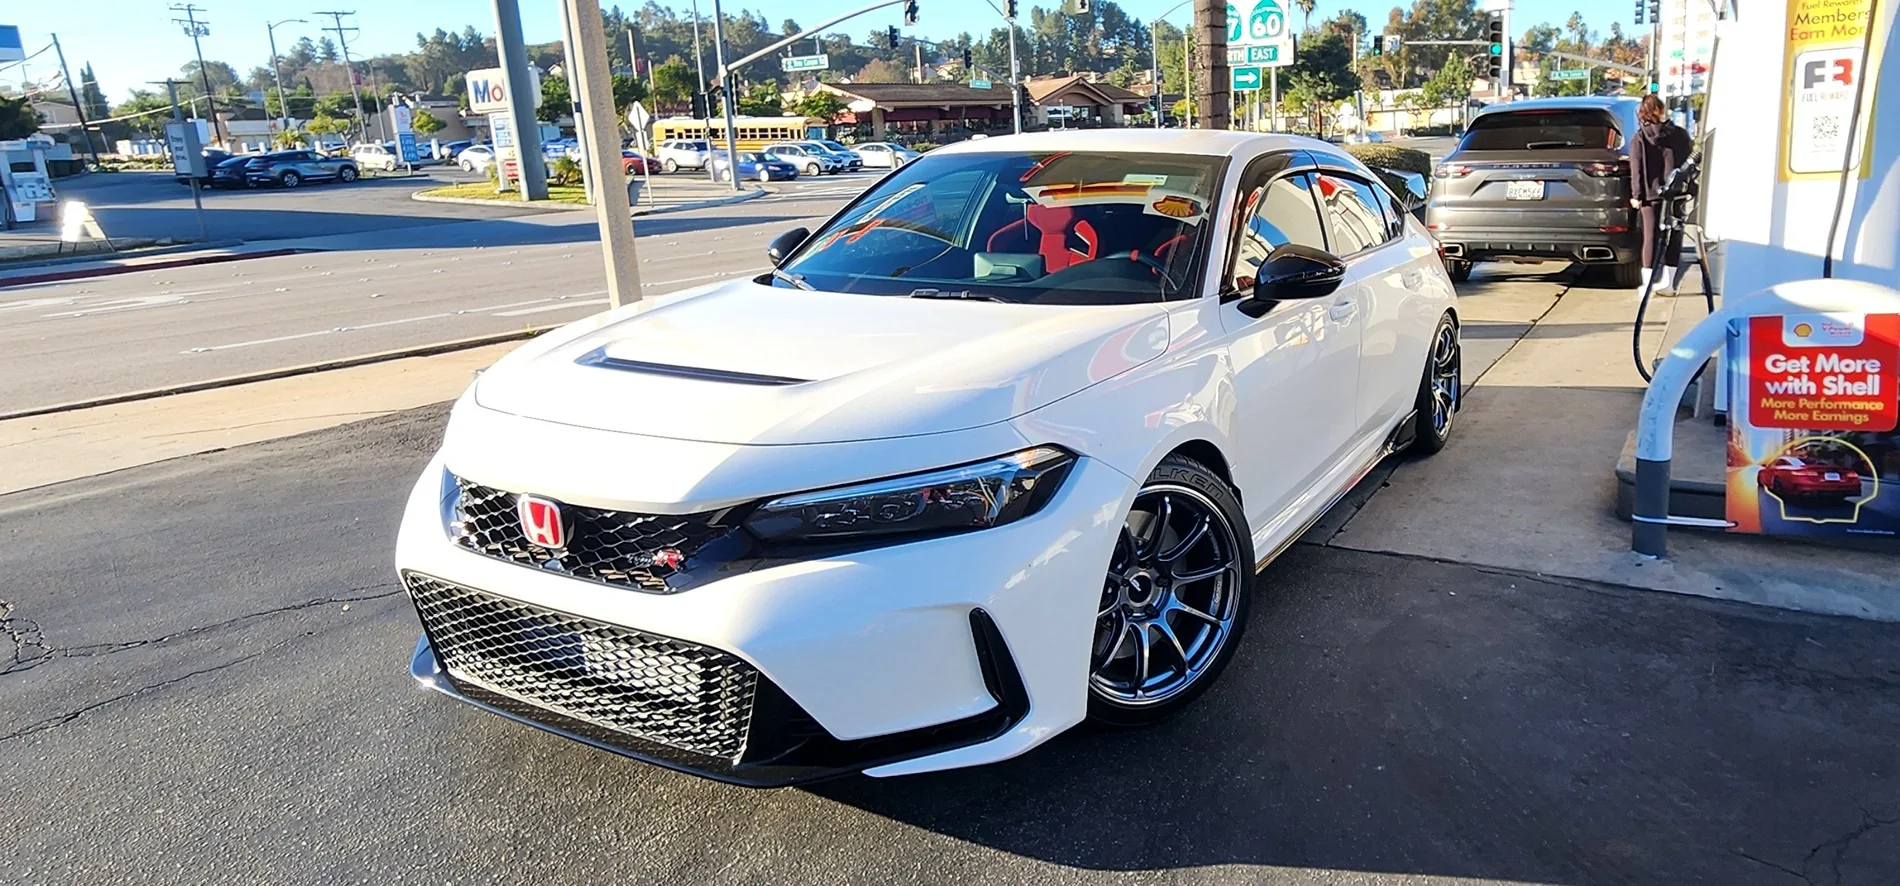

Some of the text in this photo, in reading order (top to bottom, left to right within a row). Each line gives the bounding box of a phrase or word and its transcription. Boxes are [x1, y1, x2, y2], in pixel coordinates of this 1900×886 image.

[1801, 1, 1820, 10] Fuel
[1794, 8, 1870, 25] Members
[1252, 13, 1281, 37] 60
[1790, 24, 1866, 40] Earn Mor
[1227, 48, 1275, 62] RTH EAST
[472, 79, 507, 104] Mo
[1765, 353, 1881, 373] Get More
[1765, 374, 1881, 396] with Shell
[1761, 398, 1885, 411] More Performance
[1774, 410, 1869, 425] More Earnings
